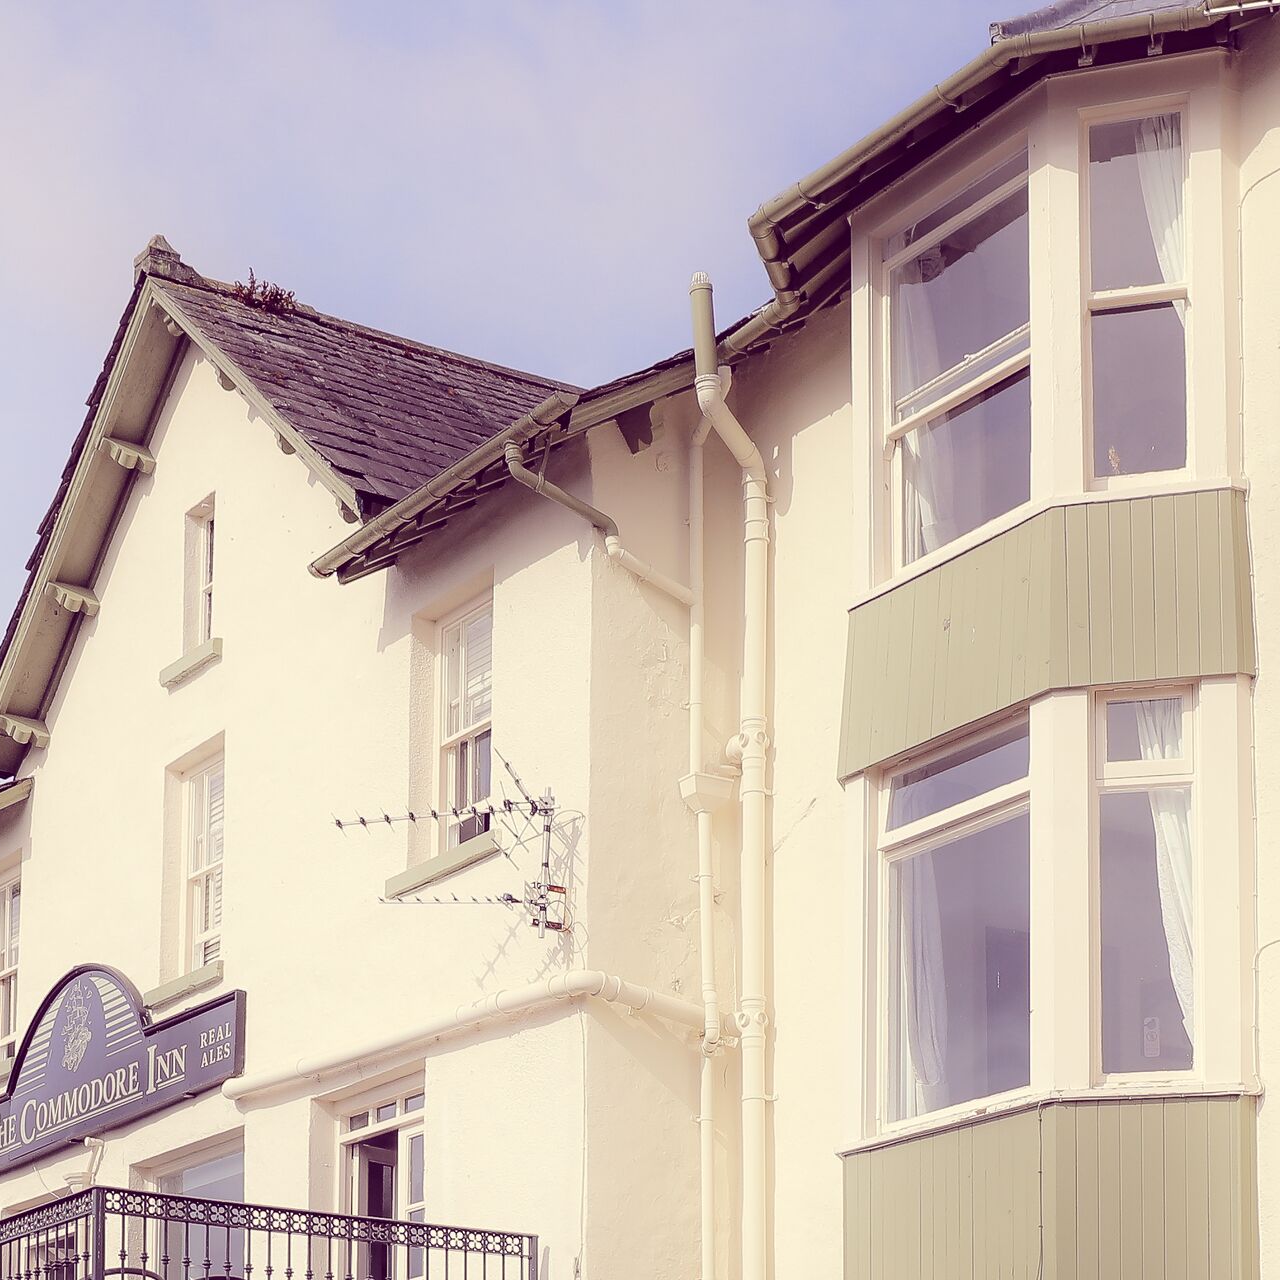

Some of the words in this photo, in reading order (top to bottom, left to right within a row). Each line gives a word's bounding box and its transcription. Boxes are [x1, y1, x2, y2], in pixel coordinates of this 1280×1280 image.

[199, 1022, 232, 1050] REAL
[200, 1042, 231, 1068] ALES
[19, 1060, 140, 1145] COMMODORE
[145, 1044, 188, 1096] INN
